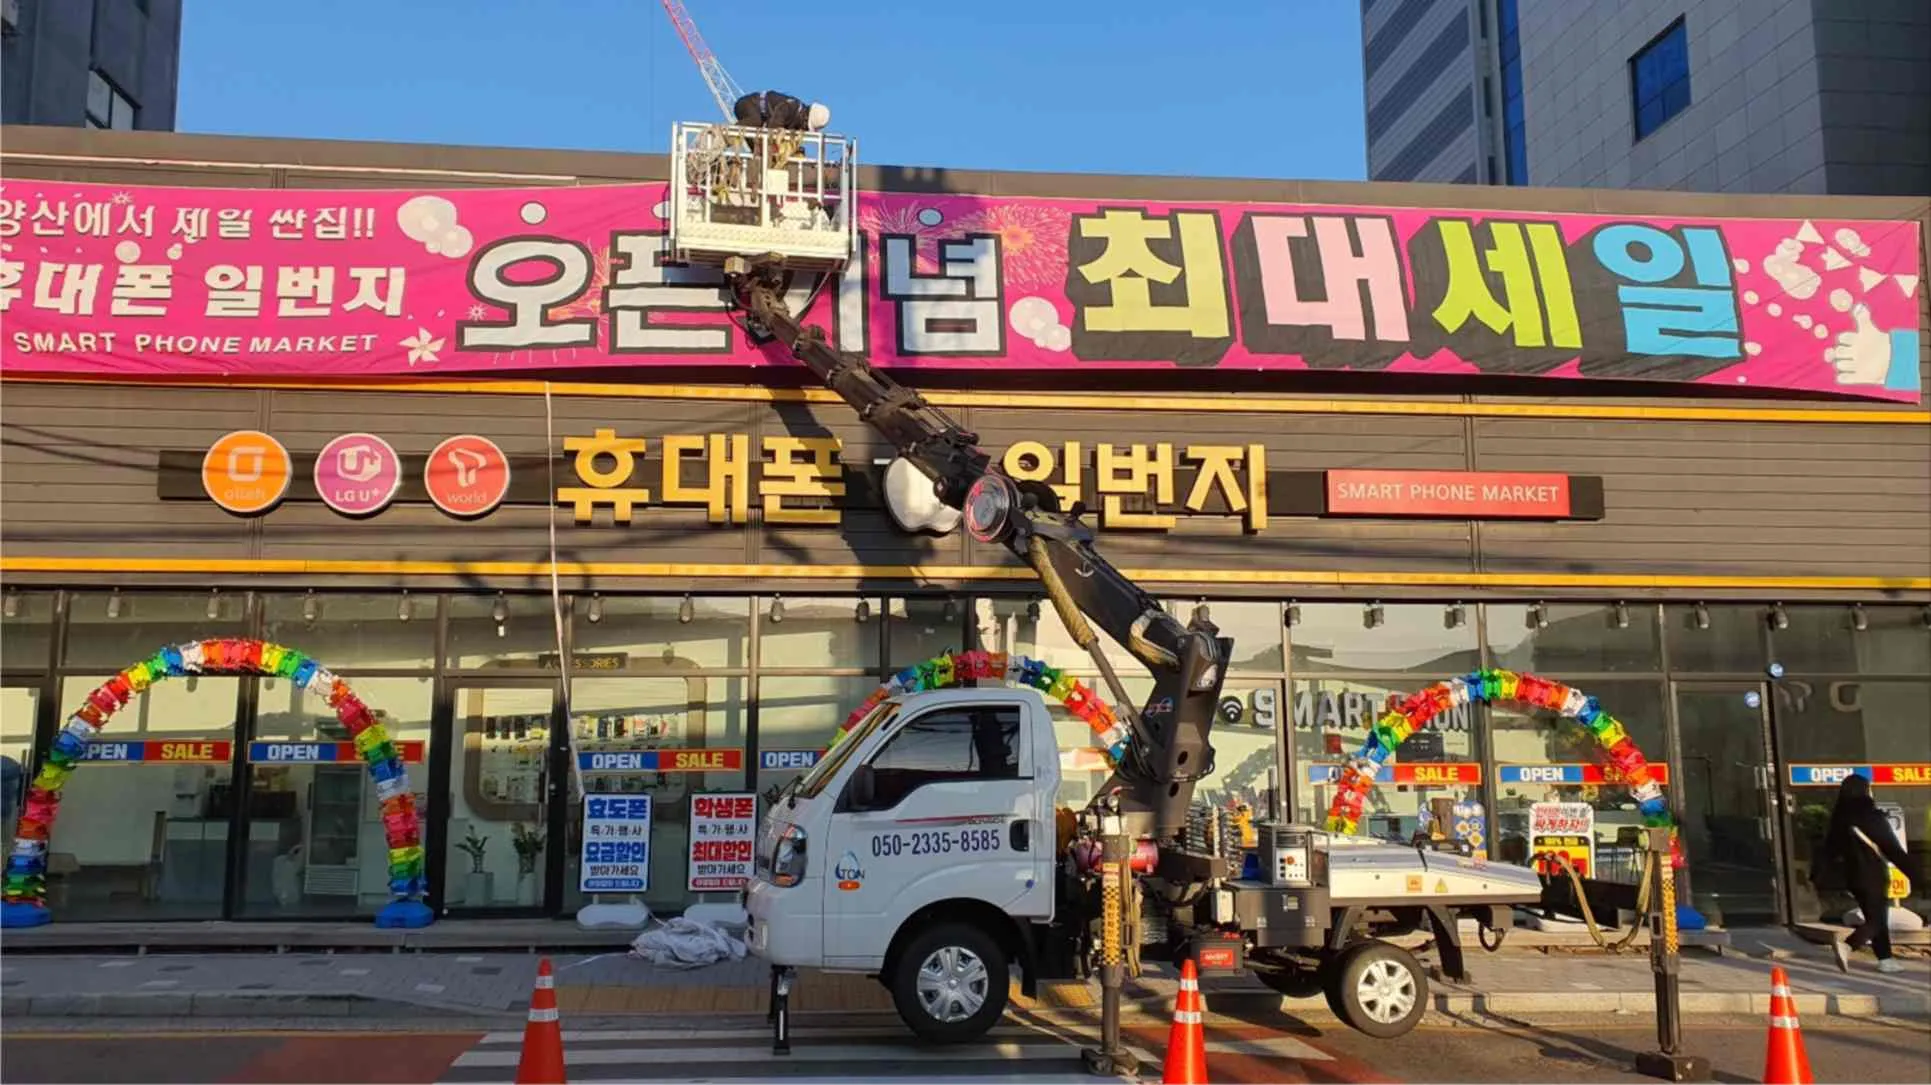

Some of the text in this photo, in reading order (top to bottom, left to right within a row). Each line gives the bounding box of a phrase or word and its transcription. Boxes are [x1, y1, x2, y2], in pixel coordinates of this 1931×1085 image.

[171, 206, 253, 240] 제일
[268, 207, 375, 240] 싼집!!
[204, 264, 406, 317] 일번지
[13, 331, 378, 354] SMART PHONE MARKET
[557, 428, 1268, 530] 휴대폰 일번지
[336, 487, 380, 502] LG U+
[446, 489, 487, 503] world
[1337, 482, 1559, 503] SMART PHONE MARKET
[160, 743, 214, 760] SALE
[267, 744, 319, 761] OPEN
[591, 752, 724, 769] OPEN SALE
[765, 752, 815, 768] OPEN
[1414, 766, 1459, 782] SALE
[1519, 767, 1564, 782] OPEN
[587, 797, 647, 819] 효도폰
[694, 797, 753, 819] 학생폰
[585, 841, 646, 863] 요금할인
[692, 840, 753, 862] 최대할인
[872, 829, 1001, 857] 050-2335-8585
[590, 865, 640, 876] 받아가세요
[697, 863, 746, 875] 받아가세요
